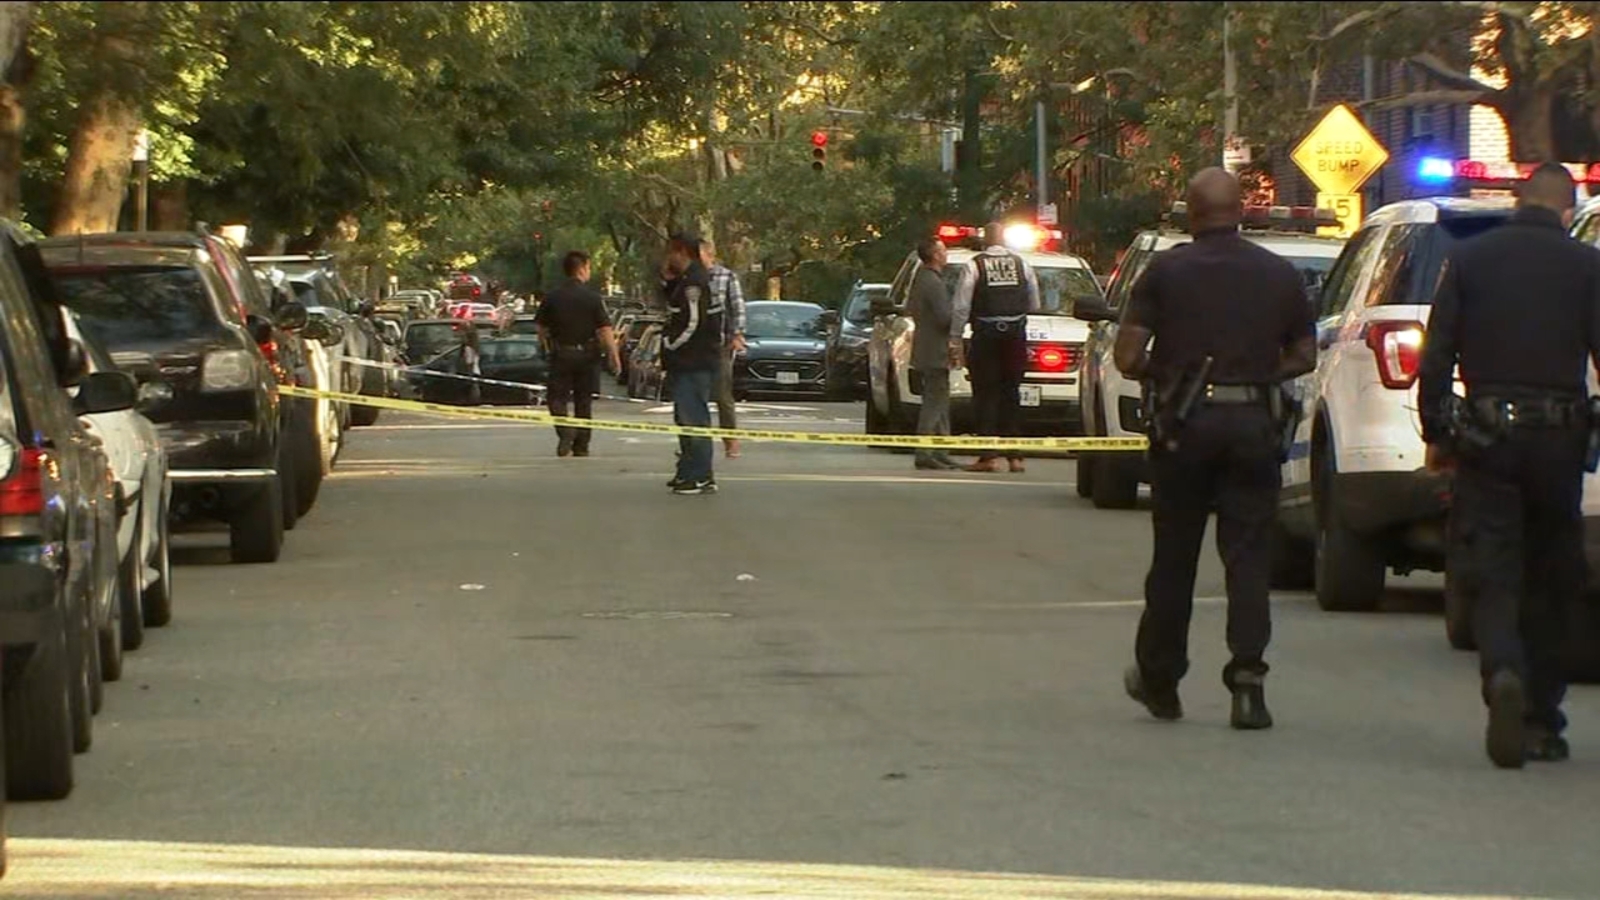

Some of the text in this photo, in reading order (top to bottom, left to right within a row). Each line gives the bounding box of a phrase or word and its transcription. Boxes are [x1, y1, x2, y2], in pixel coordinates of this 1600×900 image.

[1315, 140, 1363, 155] SPEED
[1317, 159, 1360, 172] BUMP
[983, 257, 1017, 271] NYPD
[986, 270, 1020, 282] POLICE
